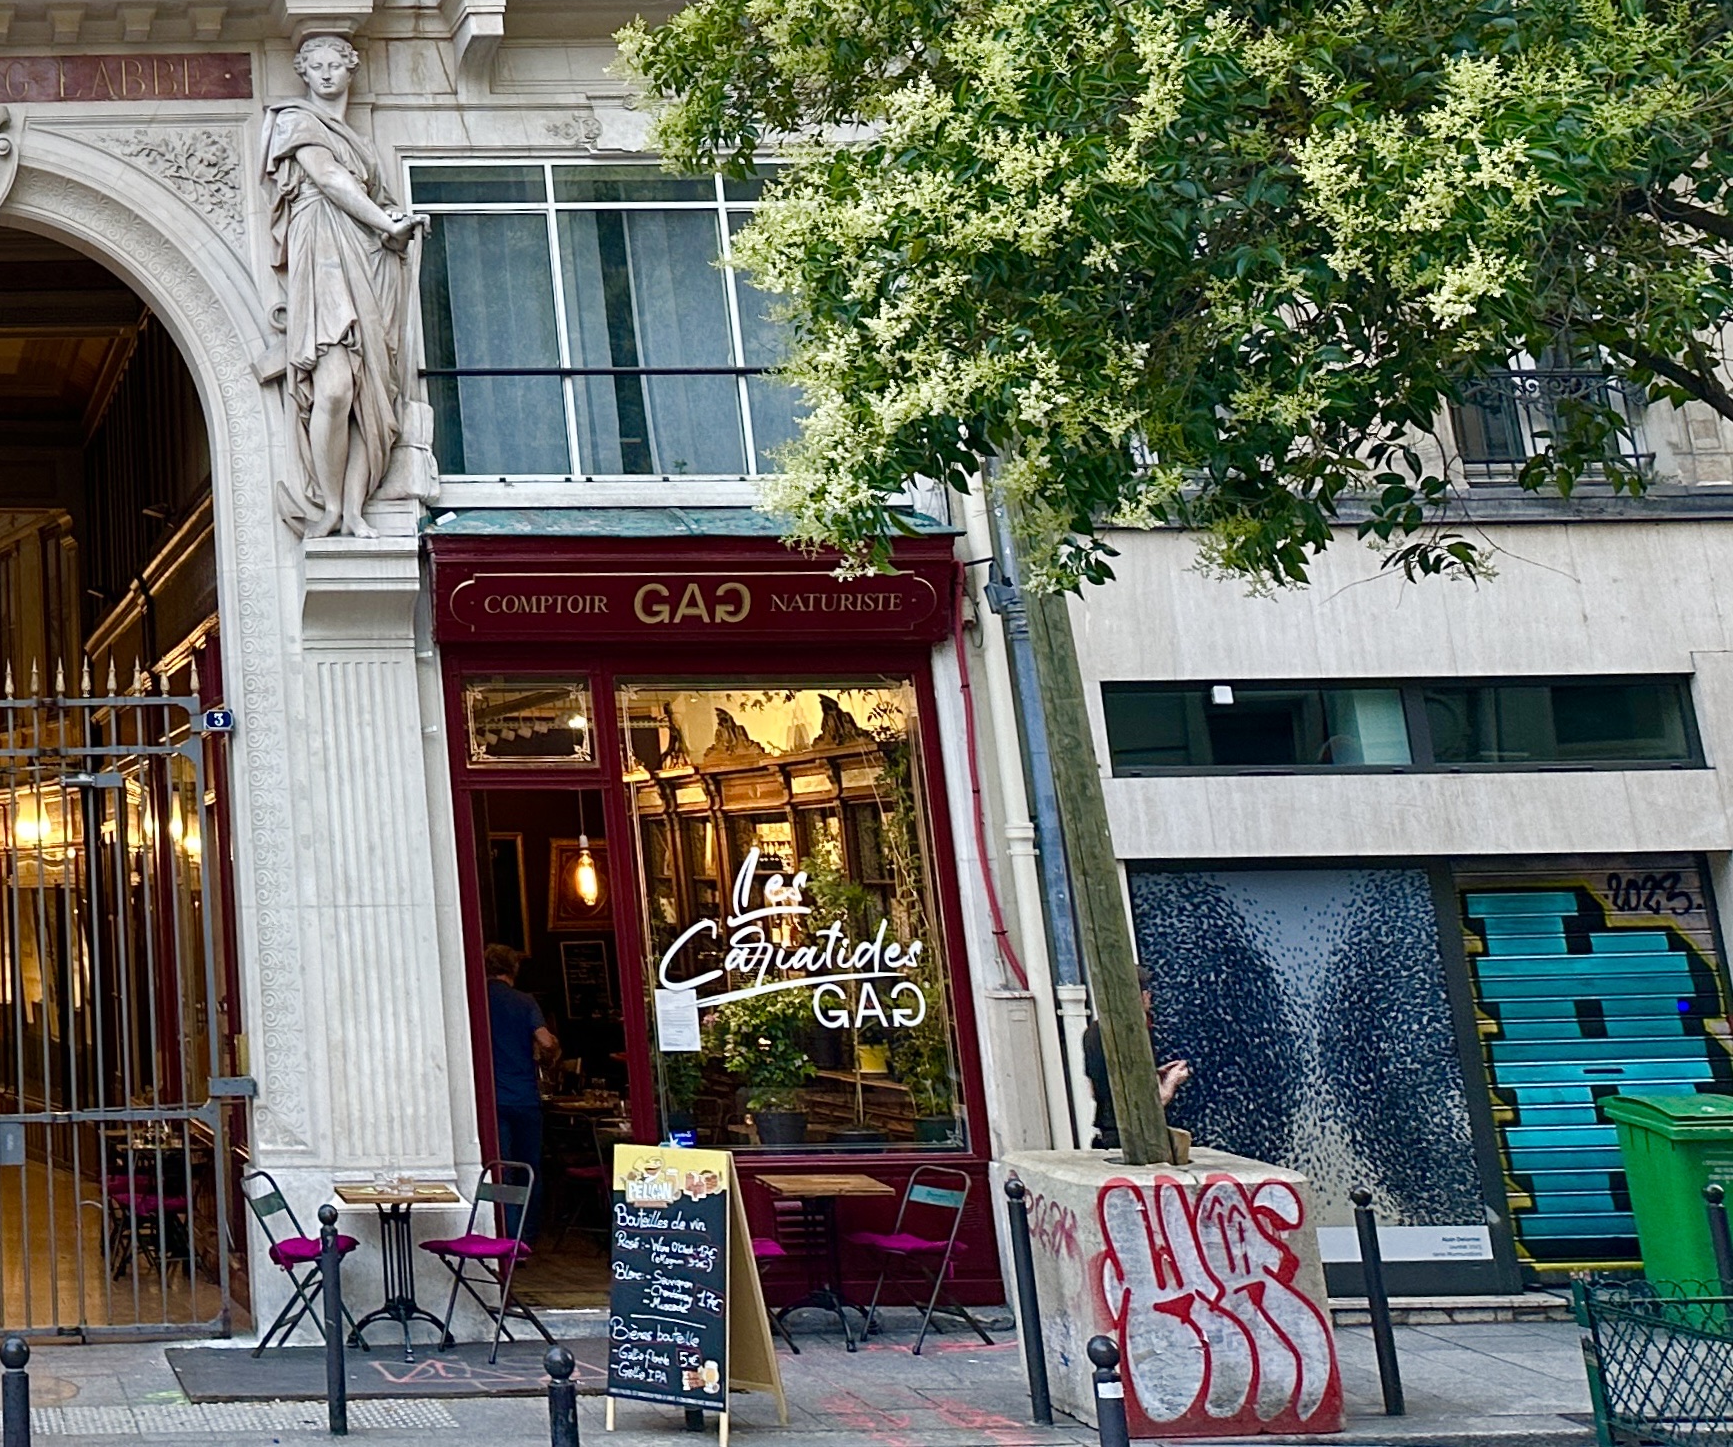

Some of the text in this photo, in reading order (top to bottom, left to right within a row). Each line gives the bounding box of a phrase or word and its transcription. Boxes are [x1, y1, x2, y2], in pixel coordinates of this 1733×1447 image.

[484, 594, 609, 615] COMPTOIR
[770, 592, 903, 613] NATURISTE
[213, 712, 224, 726] 3
[730, 847, 809, 919] Les
[659, 918, 923, 992] Cariatides
[614, 1203, 707, 1232] Bouteilles de vin
[646, 1368, 668, 1384] IPA
